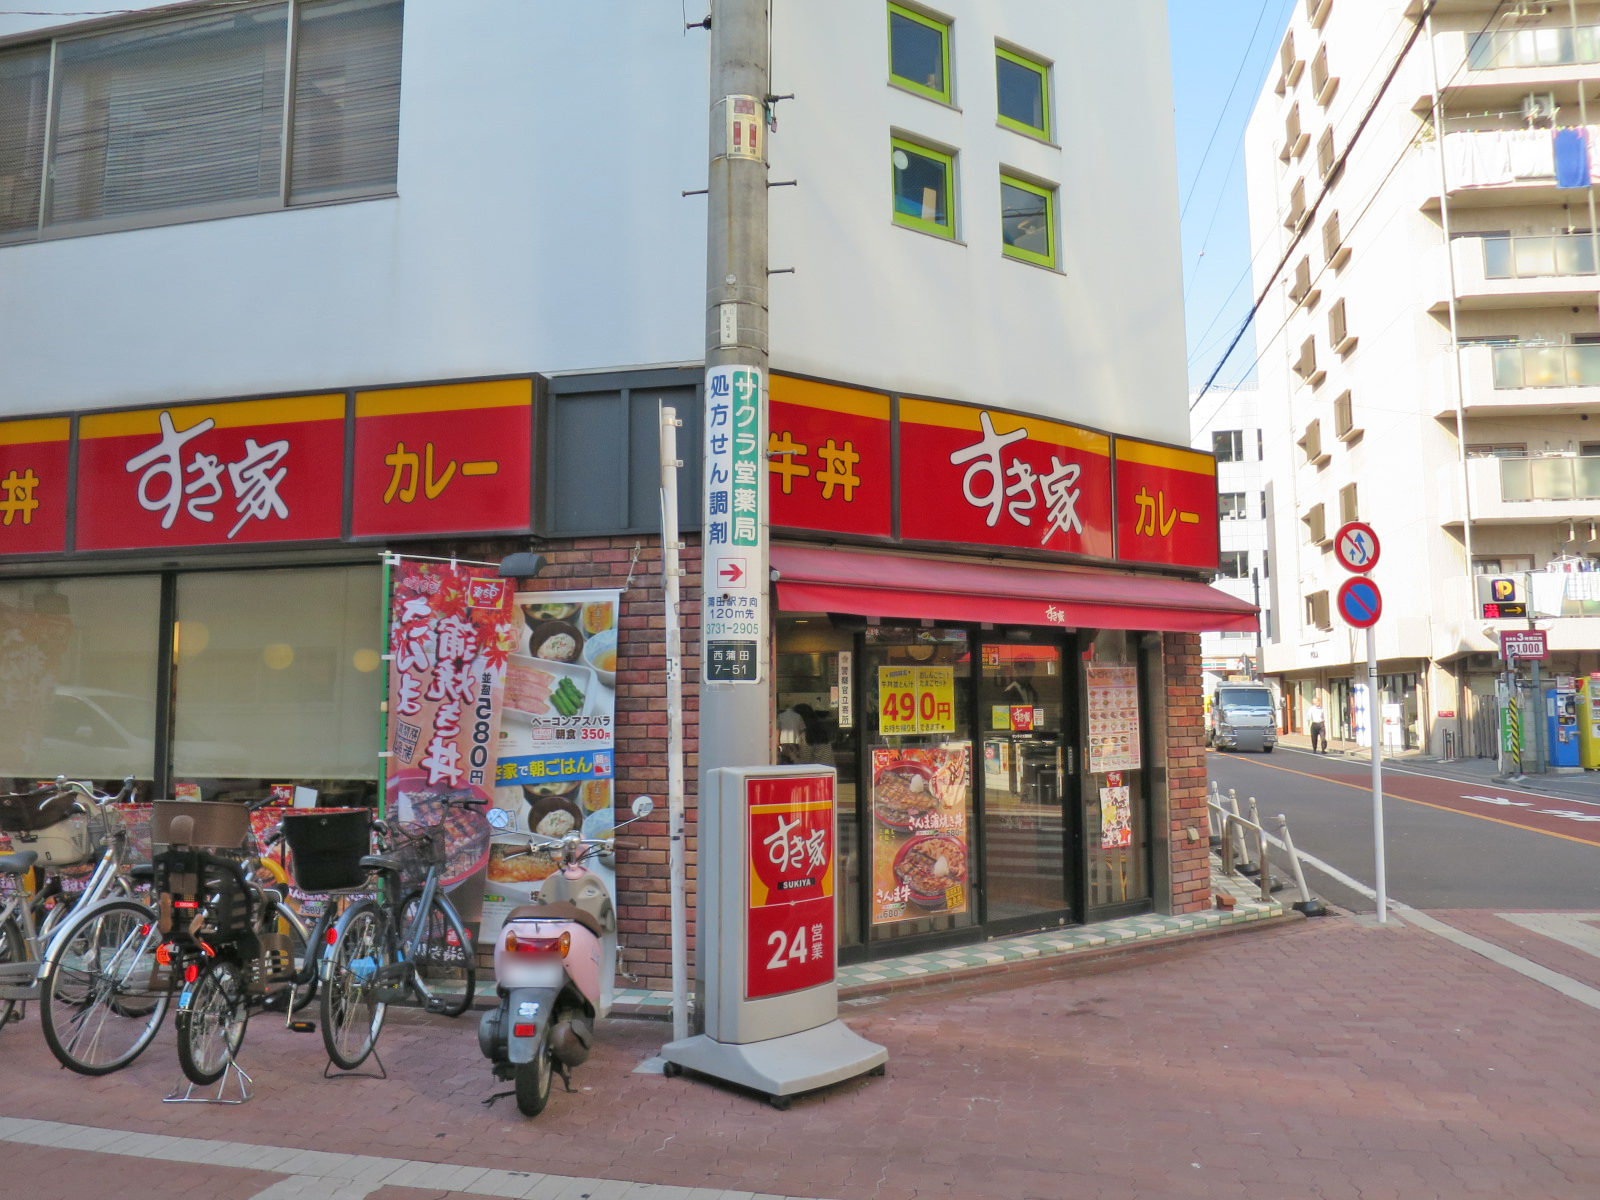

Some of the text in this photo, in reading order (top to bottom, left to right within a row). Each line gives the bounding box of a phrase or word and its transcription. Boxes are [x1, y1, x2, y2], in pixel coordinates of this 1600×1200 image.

[382, 442, 499, 505] カレー
[709, 374, 730, 546] 処方せん調剤
[734, 377, 757, 541] サクラ堂薬局
[769, 430, 861, 502] 牛丼
[126, 410, 290, 540] すき家
[949, 410, 1083, 546] すき家
[1, 468, 40, 526] 丼
[1134, 485, 1200, 537] カレー
[707, 596, 758, 608] 蒲田駅方向
[709, 608, 755, 620] 120m先
[1045, 605, 1065, 624] すき家
[706, 622, 759, 635] 3731-2905
[713, 650, 750, 661] 西蒲田
[714, 664, 747, 675] 7-51
[532, 715, 611, 727] ベーコンアスパラ
[882, 692, 951, 722] 490円
[555, 728, 576, 741] 朝食
[580, 728, 611, 741] 350円
[763, 814, 826, 876] すき家
[783, 879, 812, 889] SUKIYA
[876, 886, 911, 904] さんま牛
[766, 922, 824, 971] 24 営業
